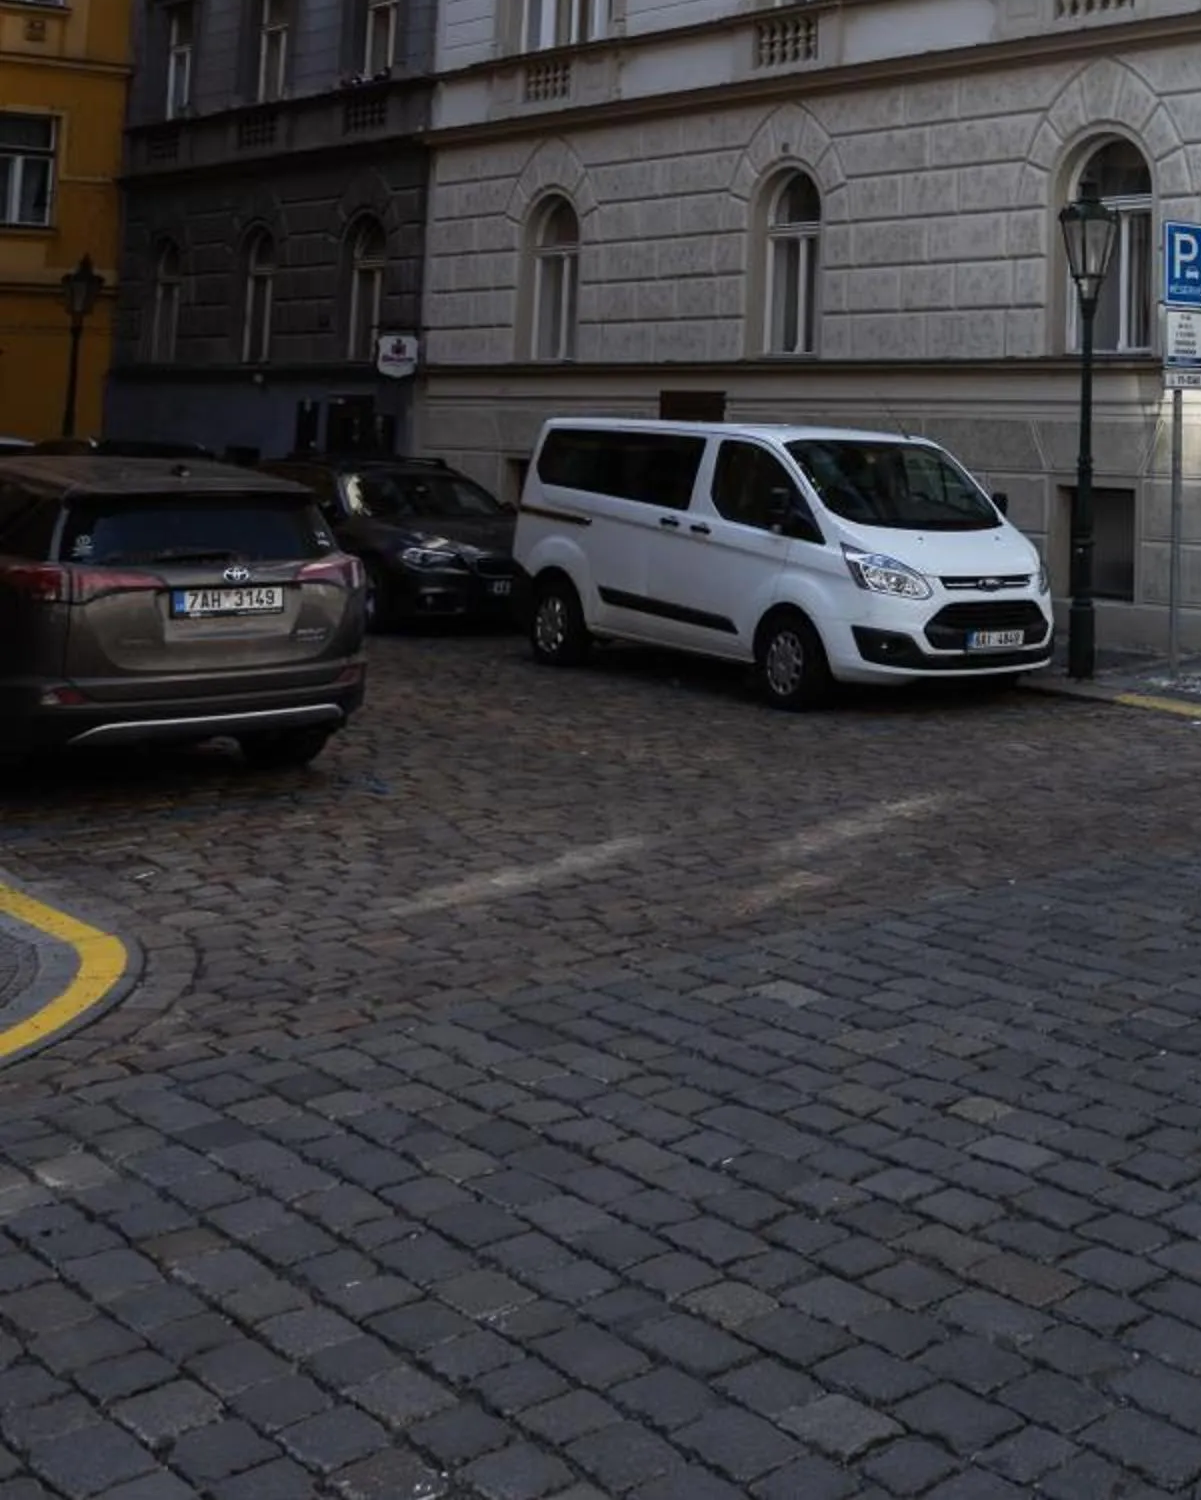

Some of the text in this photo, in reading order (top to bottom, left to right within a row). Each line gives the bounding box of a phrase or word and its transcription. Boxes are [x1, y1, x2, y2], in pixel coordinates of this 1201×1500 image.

[1174, 232, 1199, 279] P
[189, 589, 275, 609] 7AH 3149
